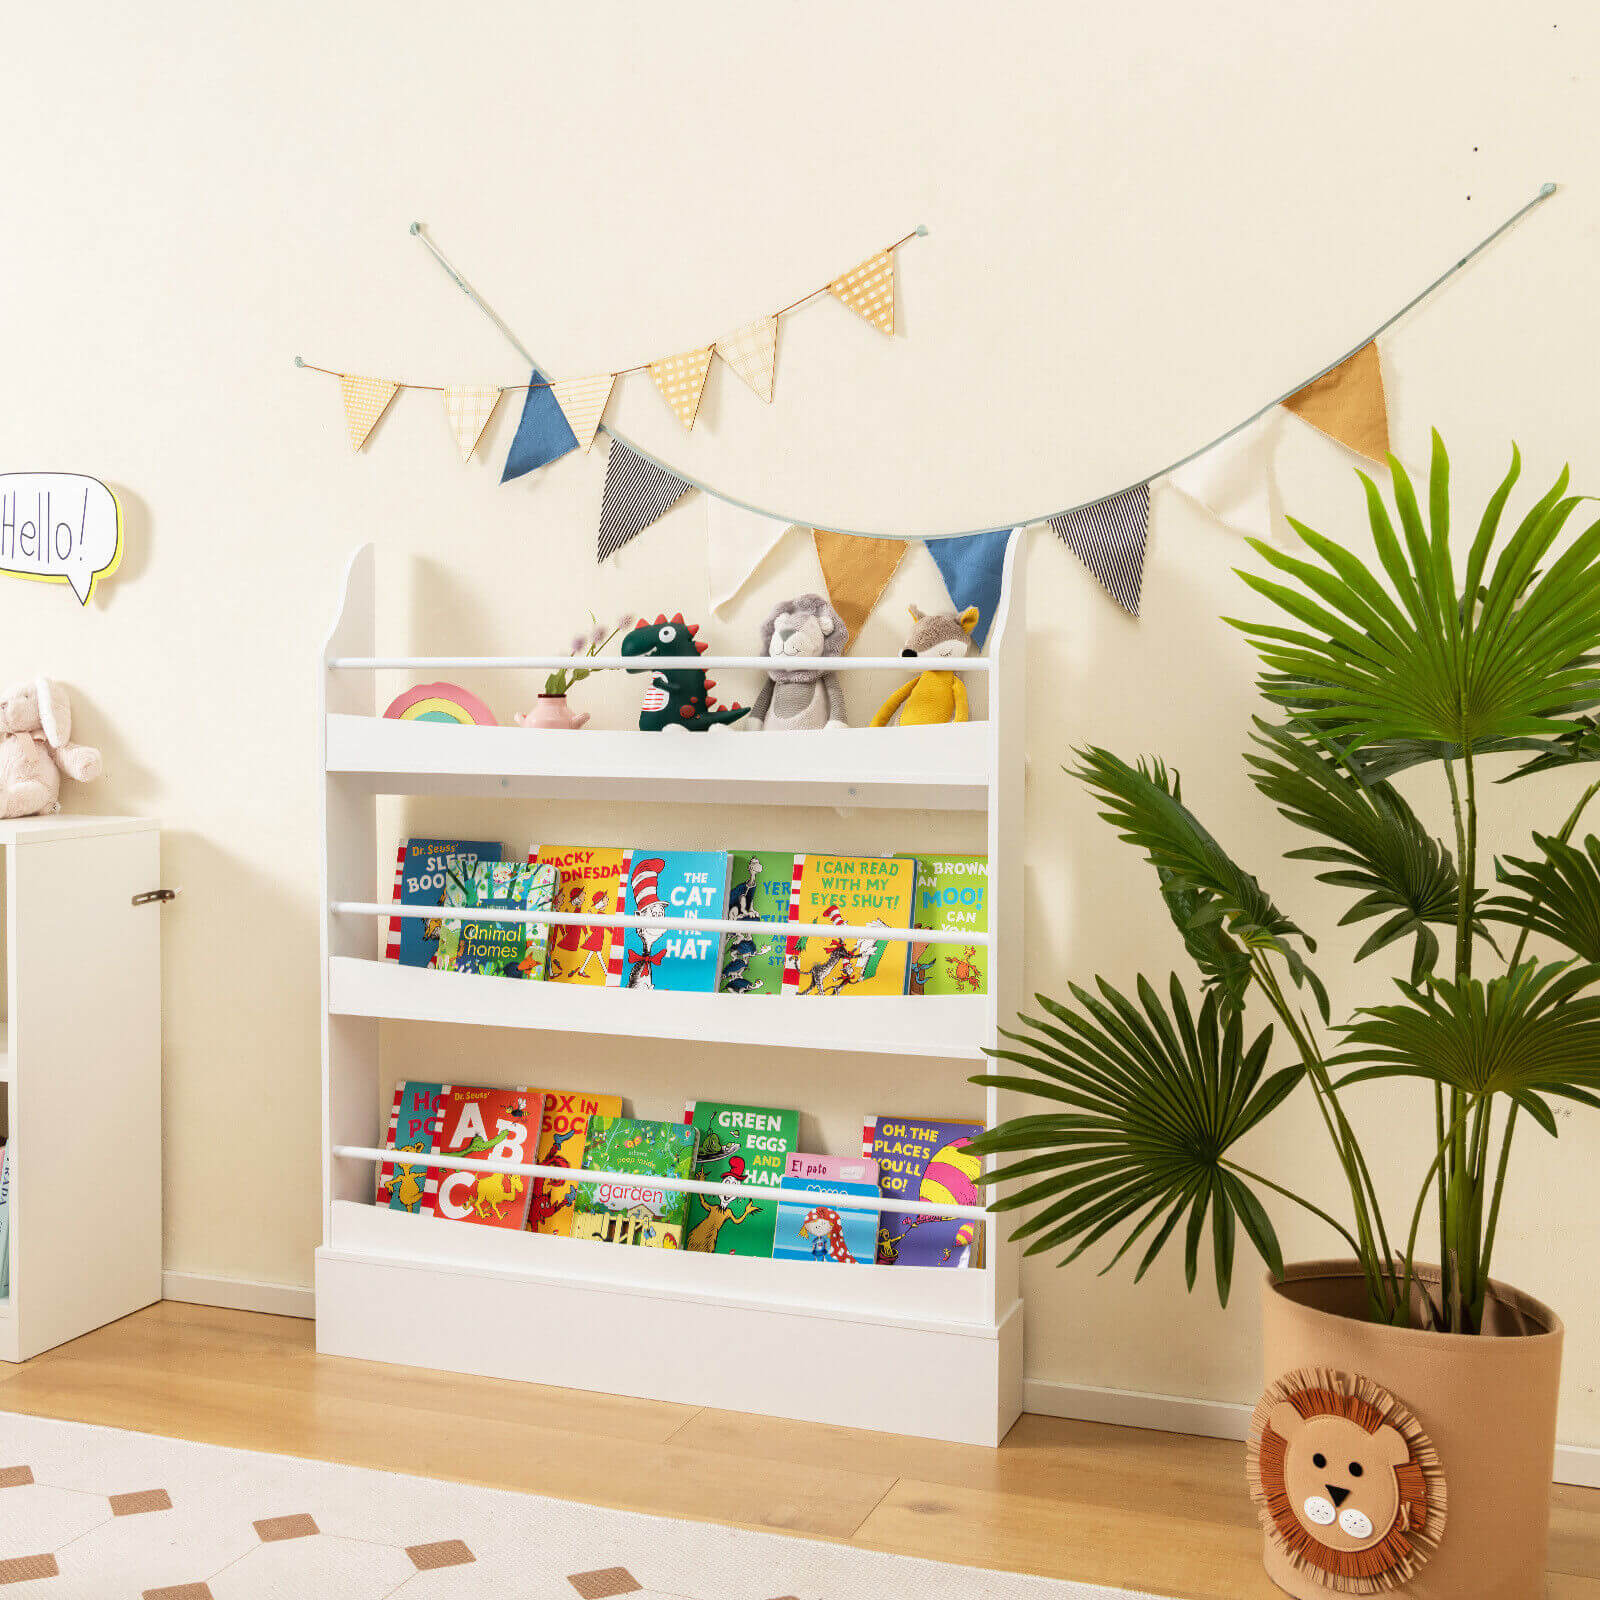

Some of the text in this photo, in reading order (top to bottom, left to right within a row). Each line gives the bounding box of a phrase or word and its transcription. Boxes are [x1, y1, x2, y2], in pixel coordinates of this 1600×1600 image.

[2, 487, 89, 565] Hello!
[411, 846, 426, 857] Dr.
[683, 872, 708, 884] THE
[816, 861, 899, 877] I CAN READ
[406, 873, 446, 894] BOO
[822, 877, 889, 891] WITH MY
[670, 886, 717, 907] CAT
[811, 892, 900, 910] EYES SHUT!
[922, 887, 985, 911] MOO!
[947, 910, 977, 924] CAN
[467, 940, 518, 958] homes
[665, 938, 713, 960] HAT
[454, 1093, 465, 1101] Dr.
[543, 1093, 598, 1116] OX IN
[448, 1102, 488, 1149] A
[718, 1111, 782, 1131] GREEN
[487, 1118, 528, 1163] B
[882, 1123, 939, 1143] OH, THE
[745, 1134, 787, 1153] EGGS
[874, 1140, 931, 1160] PLACES
[752, 1155, 781, 1168] AND
[791, 1159, 803, 1173] El
[806, 1163, 827, 1177] pato
[599, 1183, 664, 1204] garden
[881, 1176, 908, 1193] GO!
[438, 1171, 476, 1220] C
